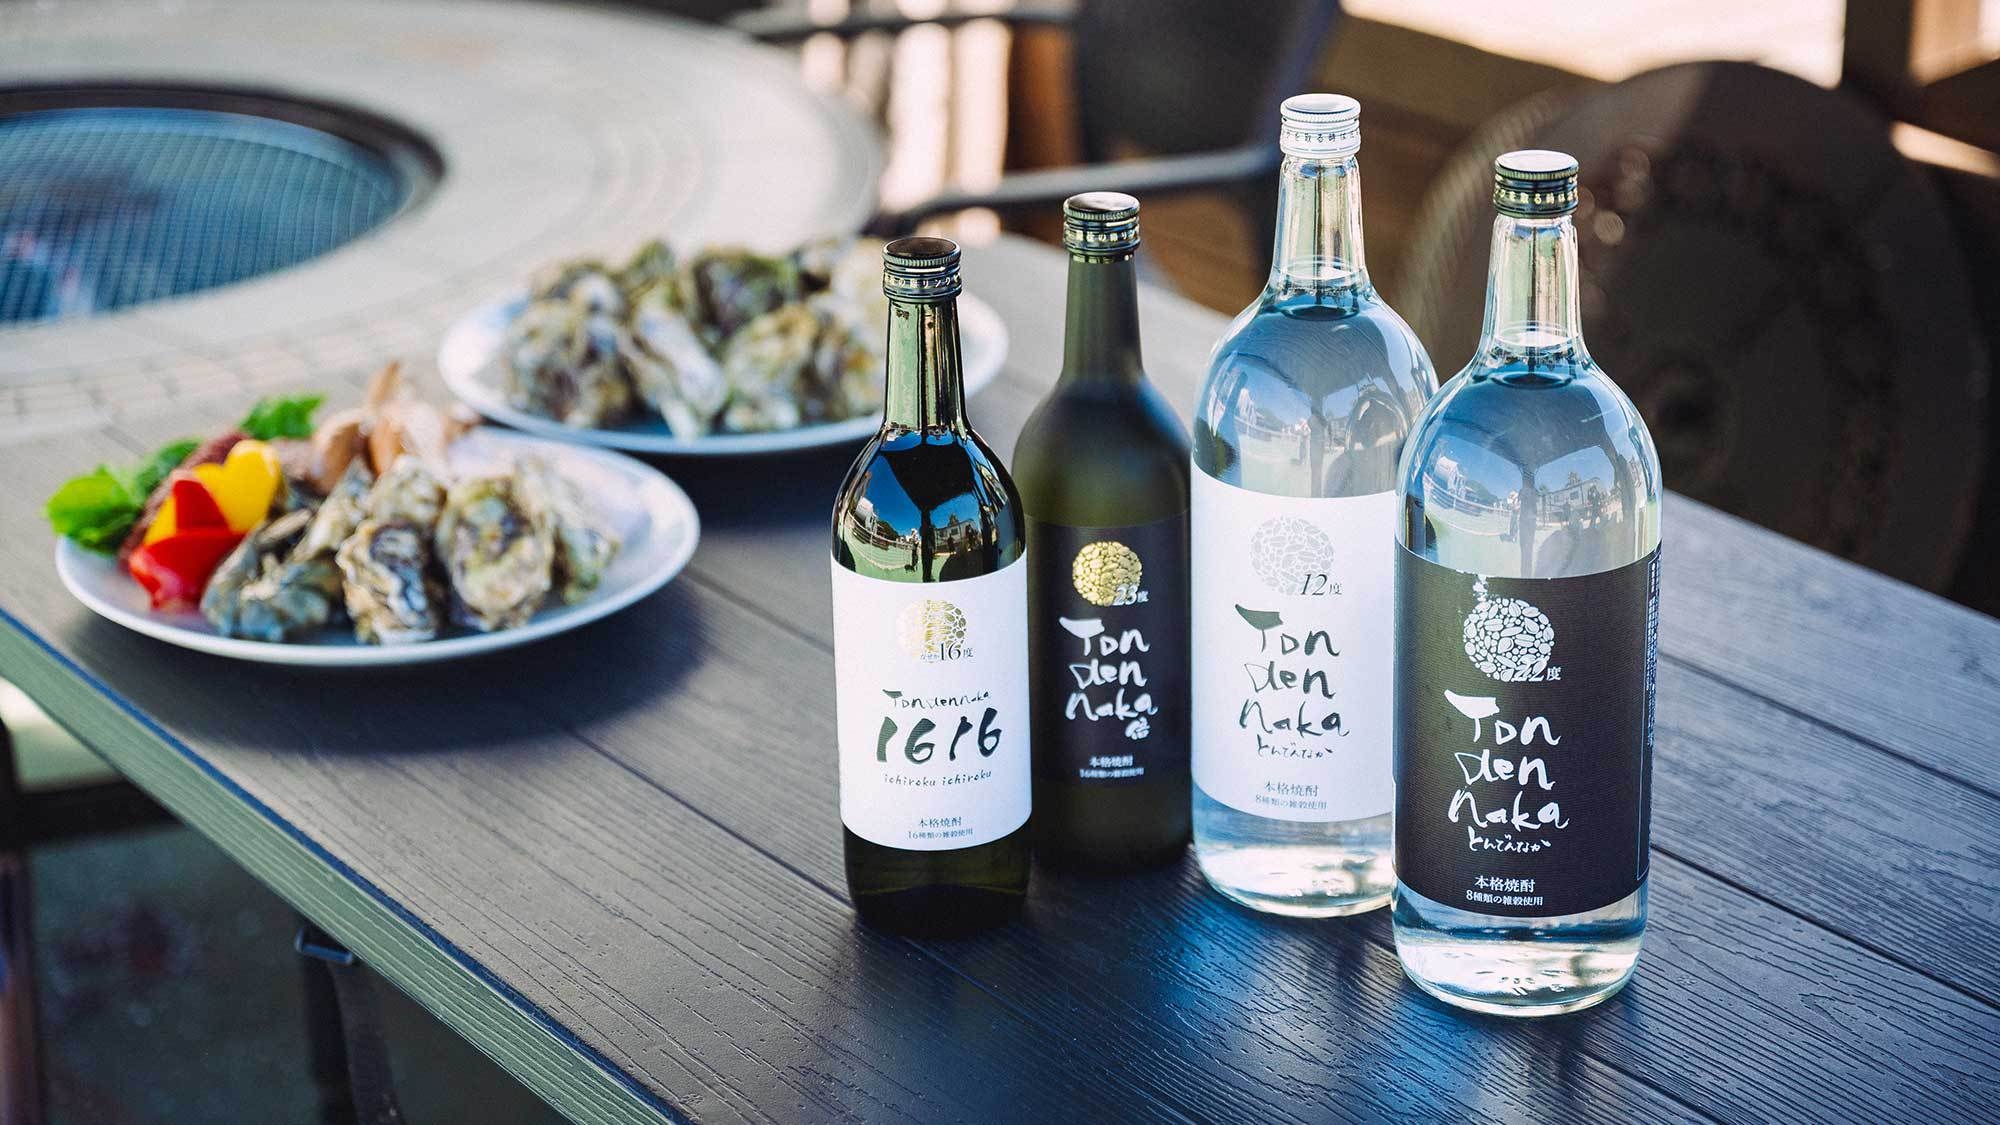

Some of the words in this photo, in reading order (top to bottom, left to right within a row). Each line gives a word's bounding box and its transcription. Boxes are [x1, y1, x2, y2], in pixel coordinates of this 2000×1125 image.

[1058, 616, 1150, 656] Ton
[1234, 603, 1341, 657] Ton
[1068, 659, 1147, 690] den
[1244, 660, 1337, 700] den
[1065, 688, 1158, 721] naka
[1239, 698, 1350, 738] naka
[1444, 689, 1561, 745] Ton
[884, 773, 936, 787] ichiroku
[942, 770, 992, 786] ichiroku
[1454, 749, 1556, 790] den
[1448, 787, 1569, 831] naka
[1466, 889, 1544, 907] 8種類の雑穀使用
[1474, 875, 1536, 893] 本格焼酎
